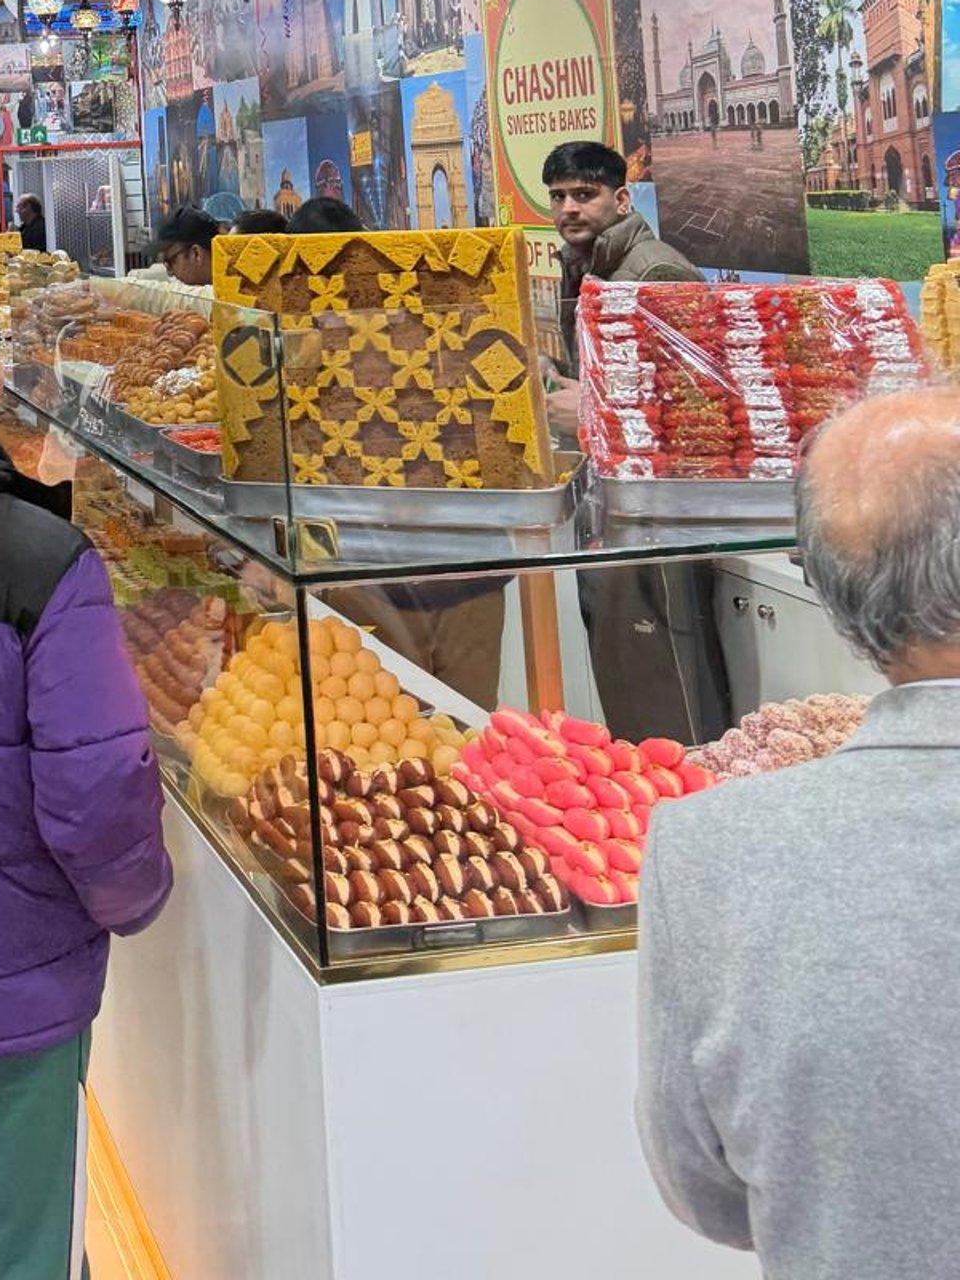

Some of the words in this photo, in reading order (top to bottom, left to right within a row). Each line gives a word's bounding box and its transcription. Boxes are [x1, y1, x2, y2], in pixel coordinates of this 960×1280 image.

[503, 54, 595, 105] CHASHNI
[507, 111, 546, 135] SWEETS
[548, 111, 556, 132] &
[559, 106, 596, 131] BAKES
